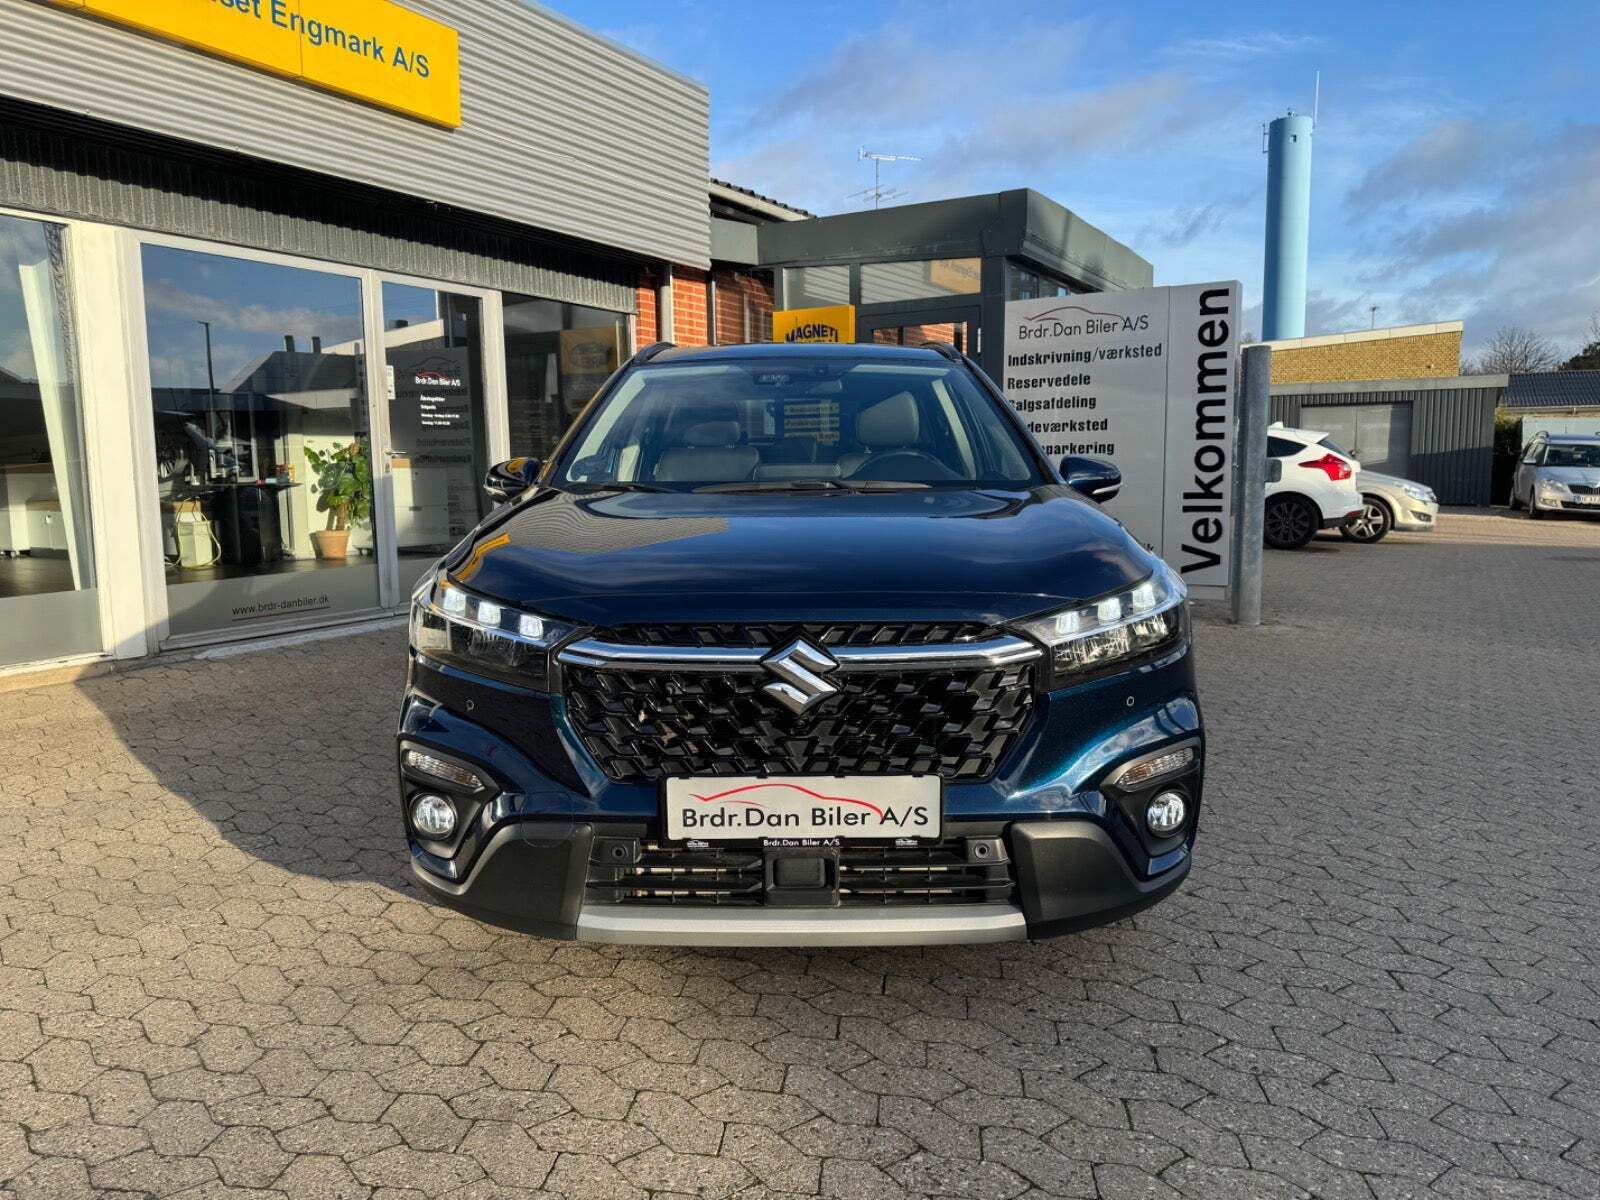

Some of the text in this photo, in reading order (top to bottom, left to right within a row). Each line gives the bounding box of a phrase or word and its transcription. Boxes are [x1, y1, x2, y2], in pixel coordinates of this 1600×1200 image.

[271, 0, 384, 63] Engmark
[392, 46, 431, 78] A/S
[1018, 315, 1149, 340] Brdr.Dan Biler A/S
[1007, 374, 1091, 390] Reservedele
[1180, 288, 1230, 574] Velkommen
[1042, 441, 1115, 456] parkering
[232, 594, 329, 615] www.brdr-danbiler.dk
[682, 806, 929, 827] Brdr.Dan Biler A/S
[763, 838, 841, 847] Brdr.Dan Biler A/S
